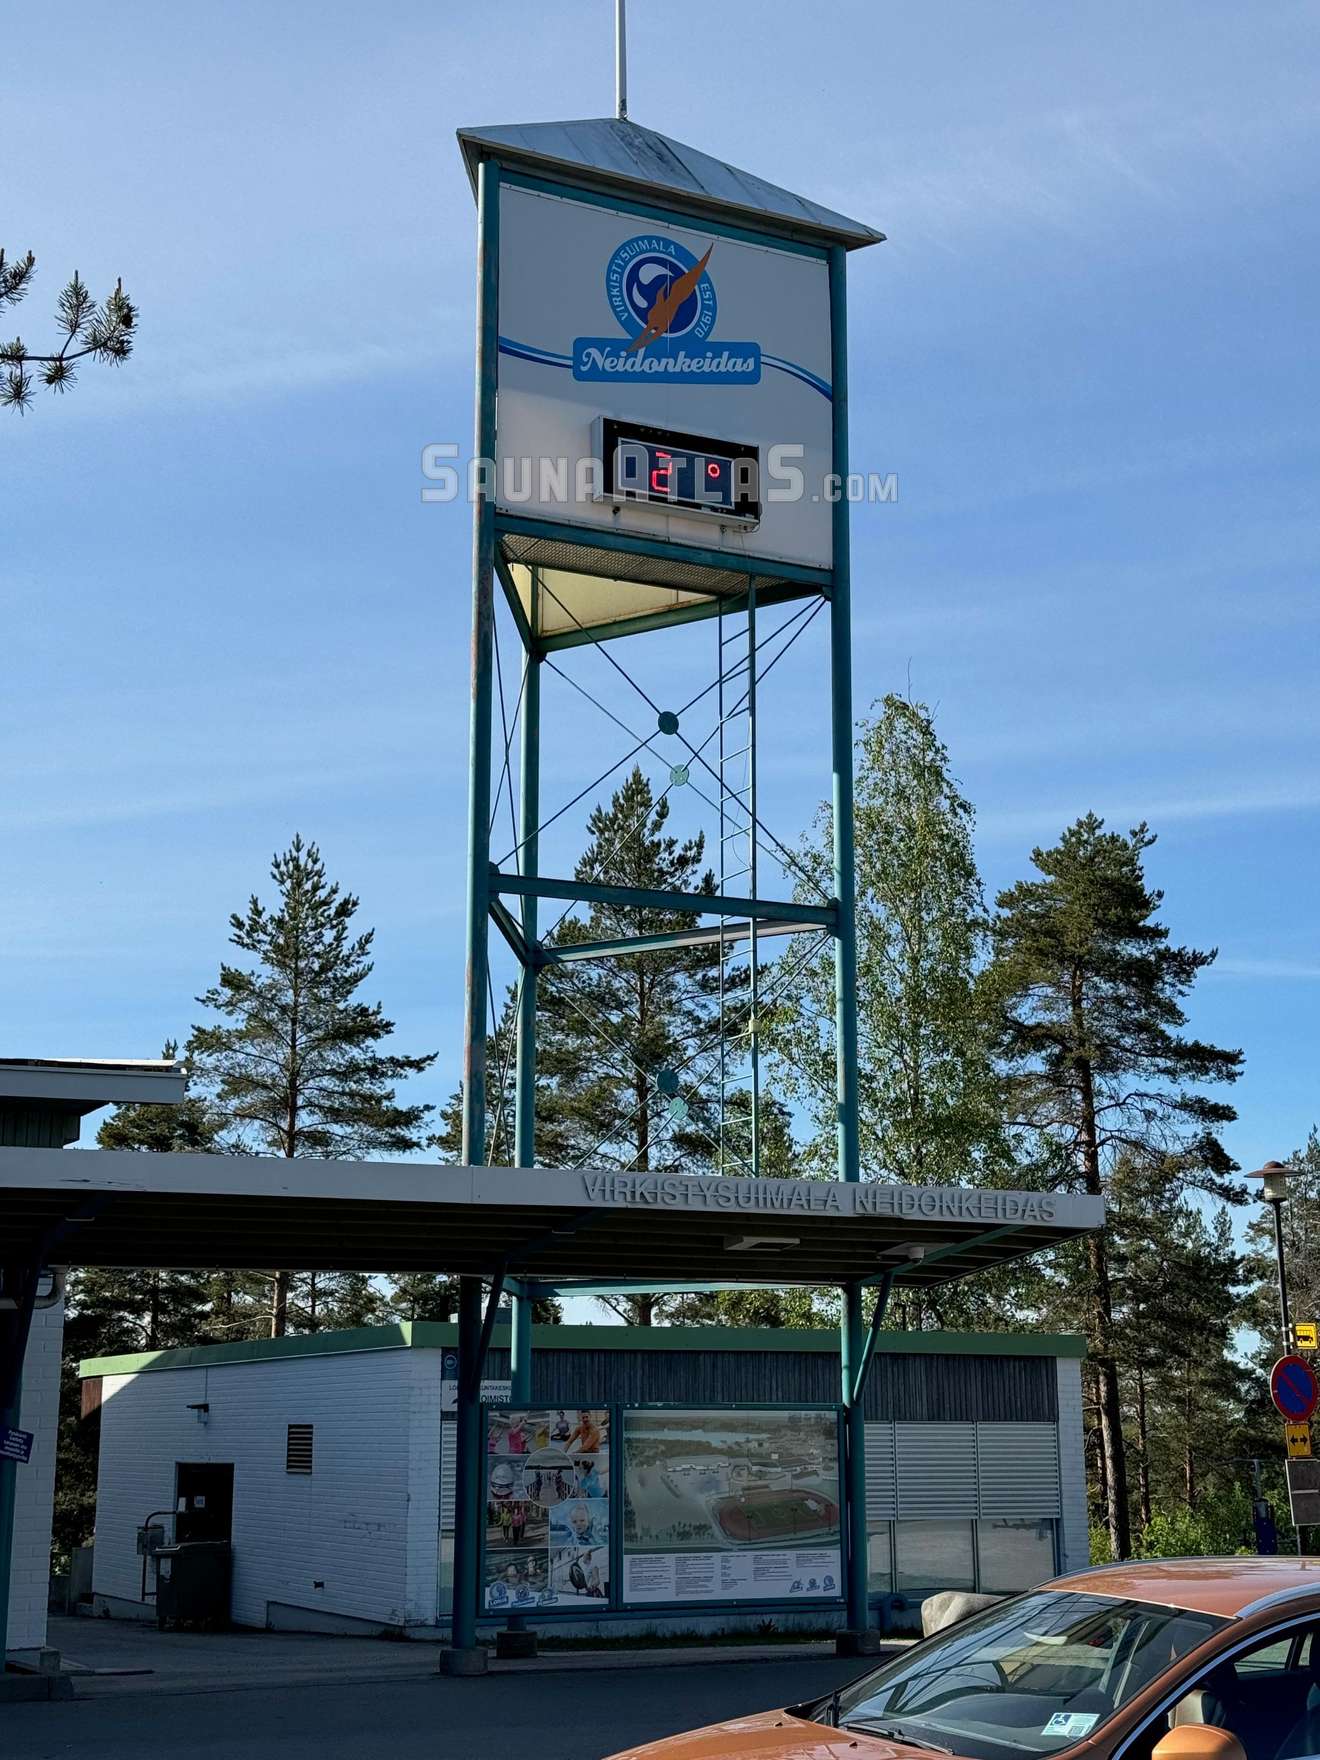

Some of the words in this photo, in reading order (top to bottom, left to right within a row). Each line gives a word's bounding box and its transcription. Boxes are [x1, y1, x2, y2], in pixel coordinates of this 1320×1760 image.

[610, 239, 676, 321] VIRKISTYSUIMALA
[700, 283, 713, 307] EST
[694, 311, 713, 338] 1970
[579, 346, 755, 373] Neidonkeidas
[583, 1174, 840, 1212] VIRKISTYSUIMALA
[853, 1187, 1057, 1223] NEIDONKEIDAS
